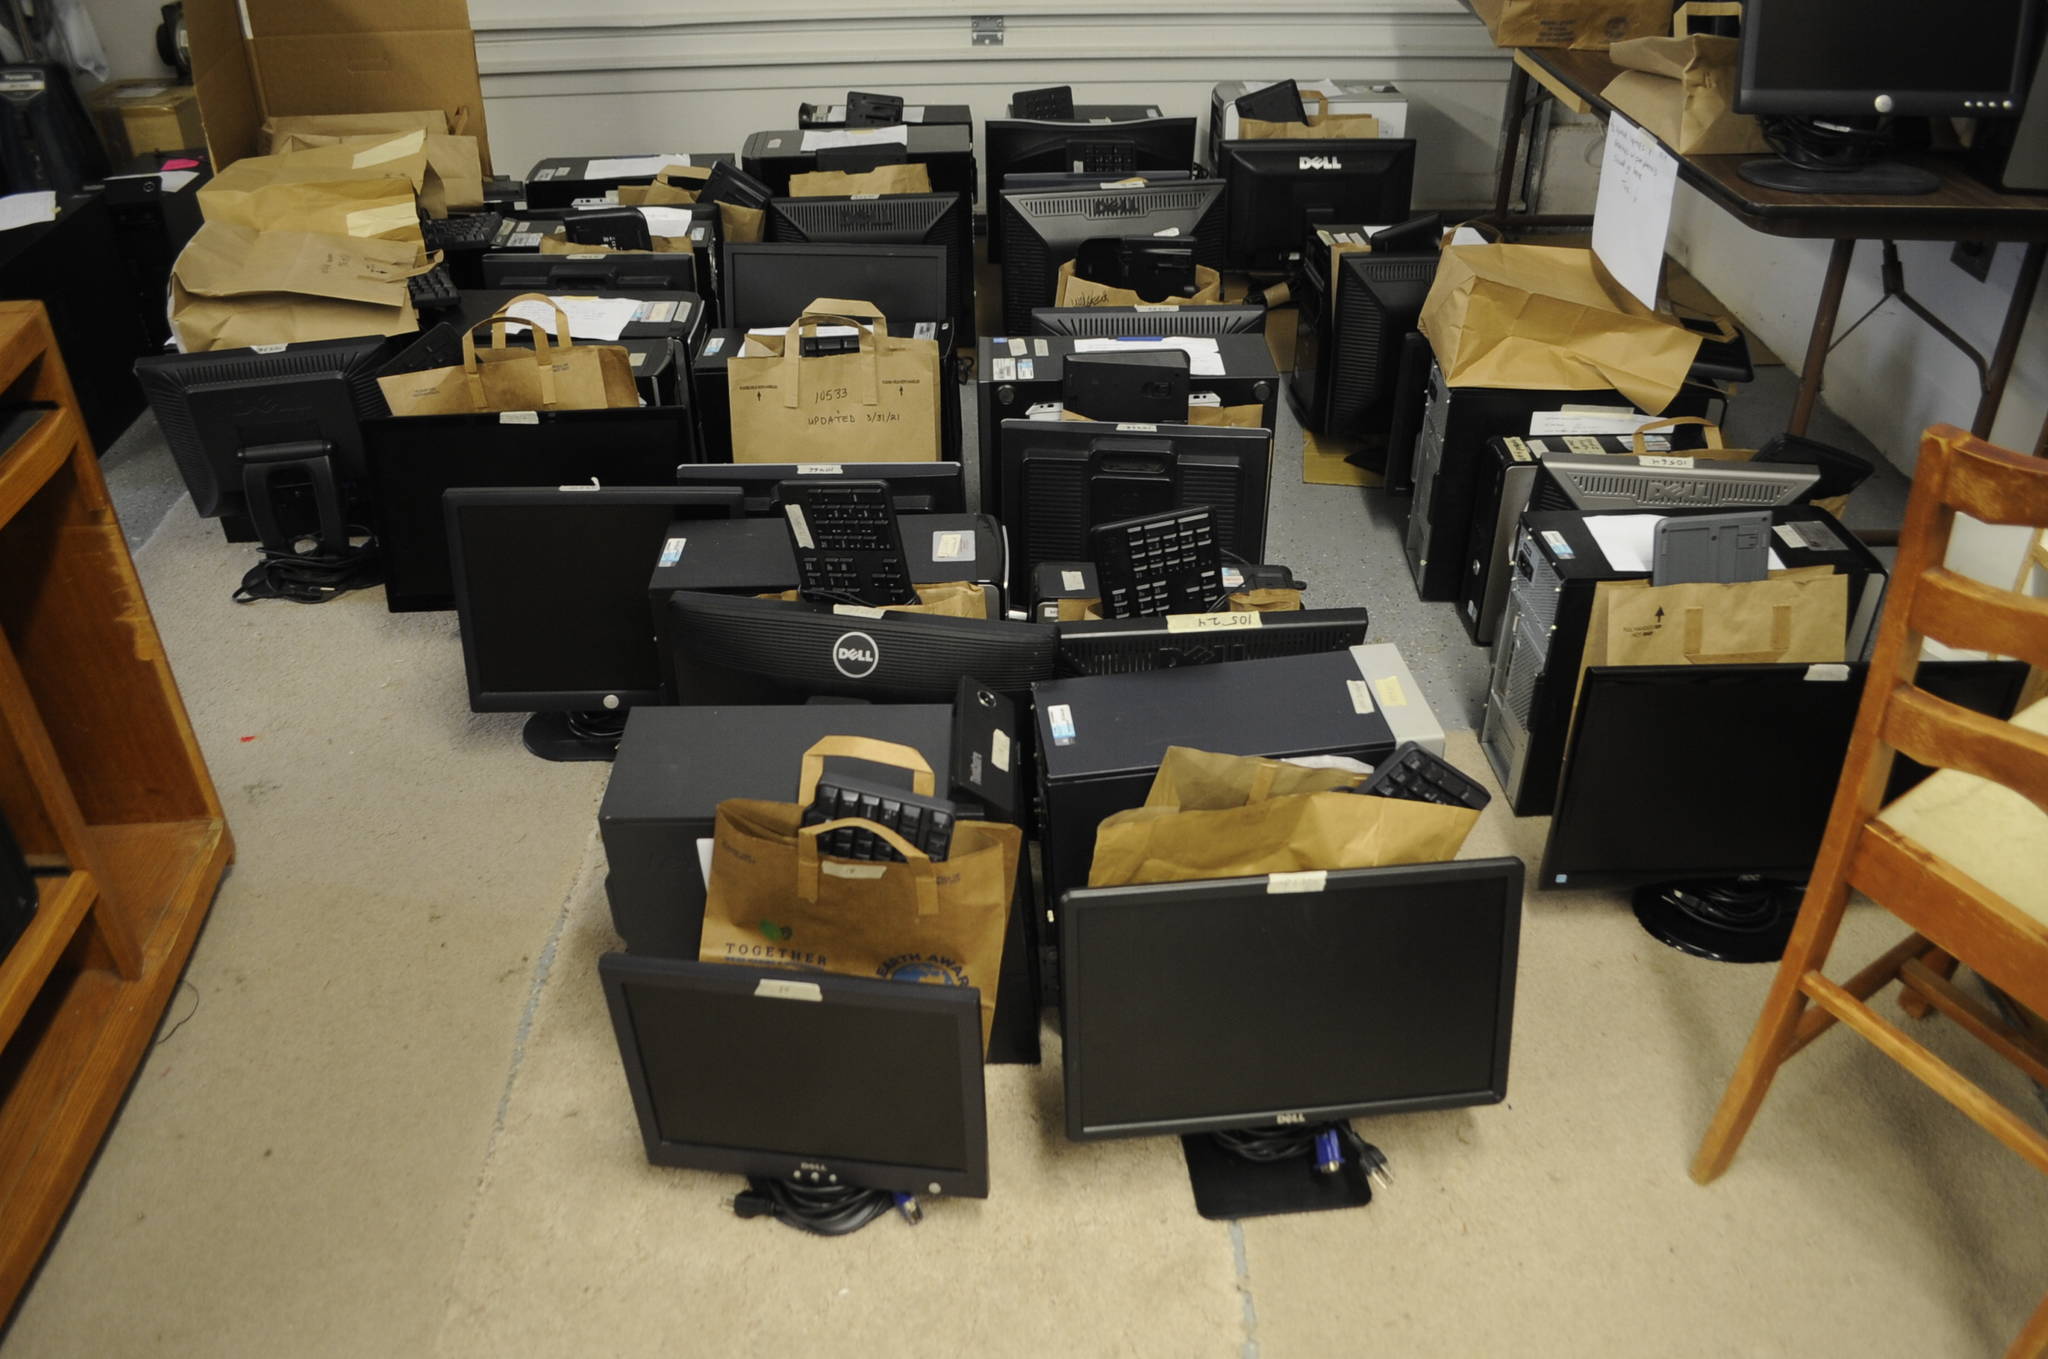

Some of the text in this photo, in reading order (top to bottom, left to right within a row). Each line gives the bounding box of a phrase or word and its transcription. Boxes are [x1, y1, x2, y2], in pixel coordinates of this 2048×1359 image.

[1299, 156, 1342, 170] DELL
[815, 388, 848, 403] 10533
[808, 414, 856, 425] UPDATED
[838, 647, 873, 662] DELL
[725, 943, 827, 965] TOGETHER
[1276, 1112, 1306, 1125] DELL
